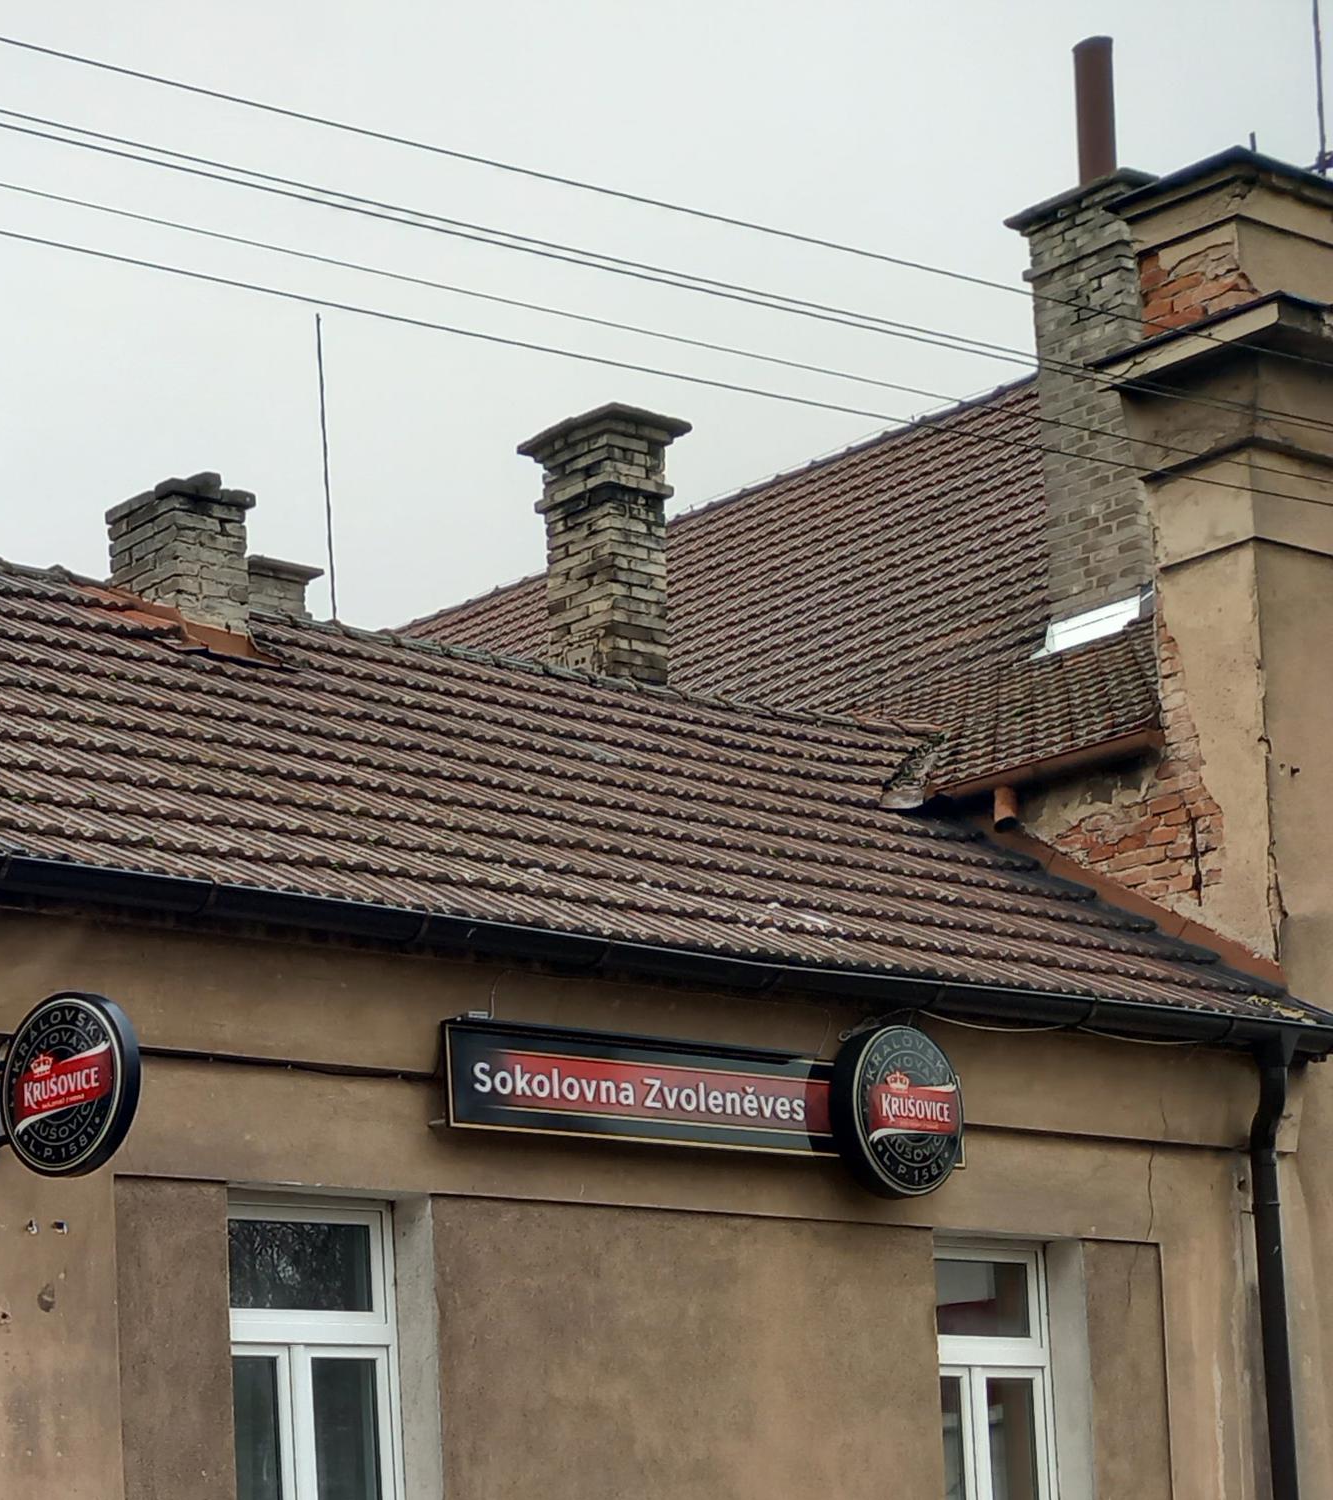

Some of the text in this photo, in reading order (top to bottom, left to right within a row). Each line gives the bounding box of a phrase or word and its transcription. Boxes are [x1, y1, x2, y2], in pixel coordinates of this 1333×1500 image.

[23, 1066, 100, 1110] KRUŠOVICE
[472, 1062, 806, 1122] Sokolovna Zvoleněves
[881, 1092, 952, 1124] KRUŠOVICE
[60, 1125, 96, 1159] 1581
